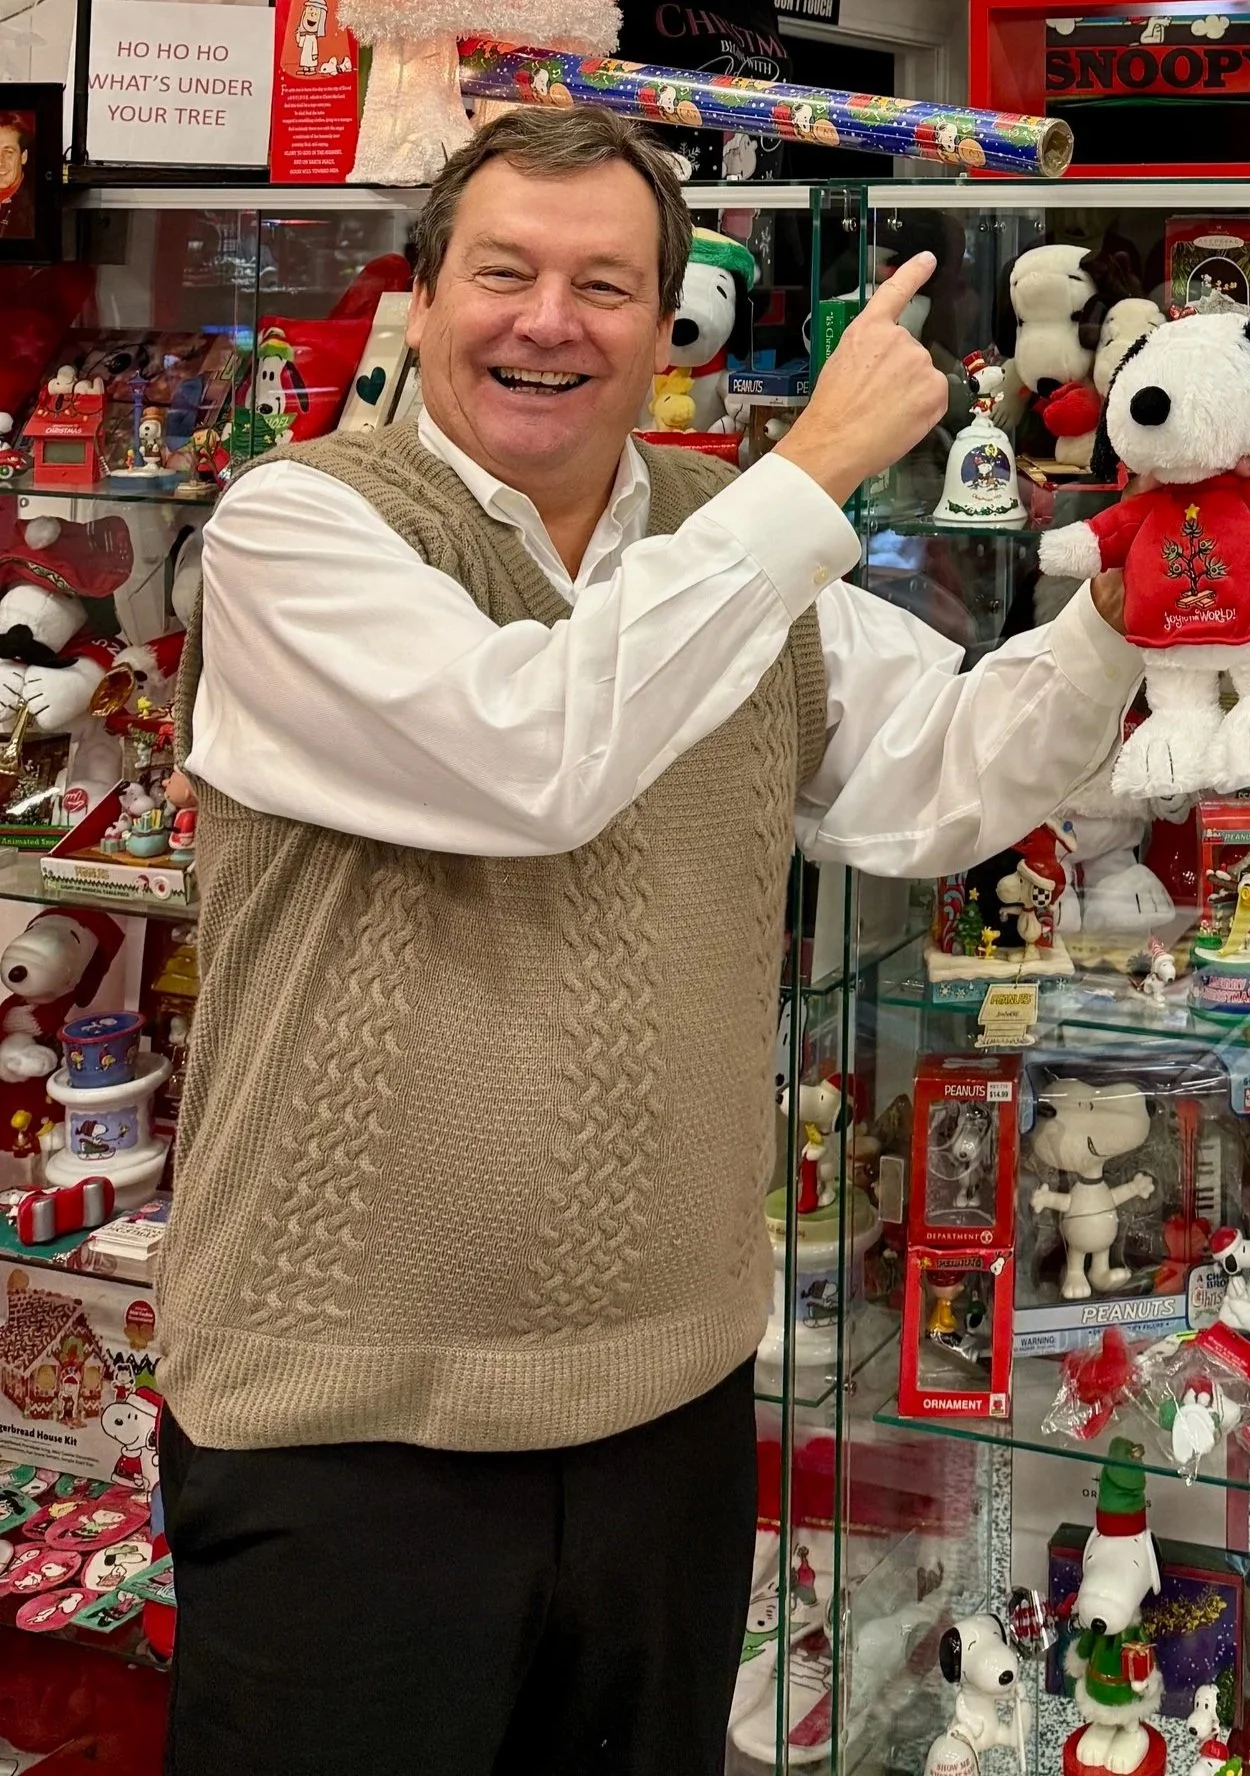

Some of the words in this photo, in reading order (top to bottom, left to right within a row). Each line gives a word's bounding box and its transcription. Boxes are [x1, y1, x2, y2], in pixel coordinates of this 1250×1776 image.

[117, 41, 150, 58] HO
[157, 43, 190, 61] HO
[196, 44, 230, 62] HO
[88, 72, 171, 92] WHAT'S
[178, 76, 254, 97] UNDER
[108, 104, 168, 125] YOUR
[174, 107, 228, 127] TREE
[732, 378, 764, 393] PEANUTS
[944, 1084, 987, 1098] PEANUTS
[926, 1232, 980, 1241] DEPARTMENT
[1081, 1299, 1176, 1325] PEANUTS
[1020, 1336, 1057, 1347] WARNING:
[923, 1399, 983, 1410] ORNAMENT
[36, 1429, 63, 1443] House
[64, 1435, 78, 1447] Kit
